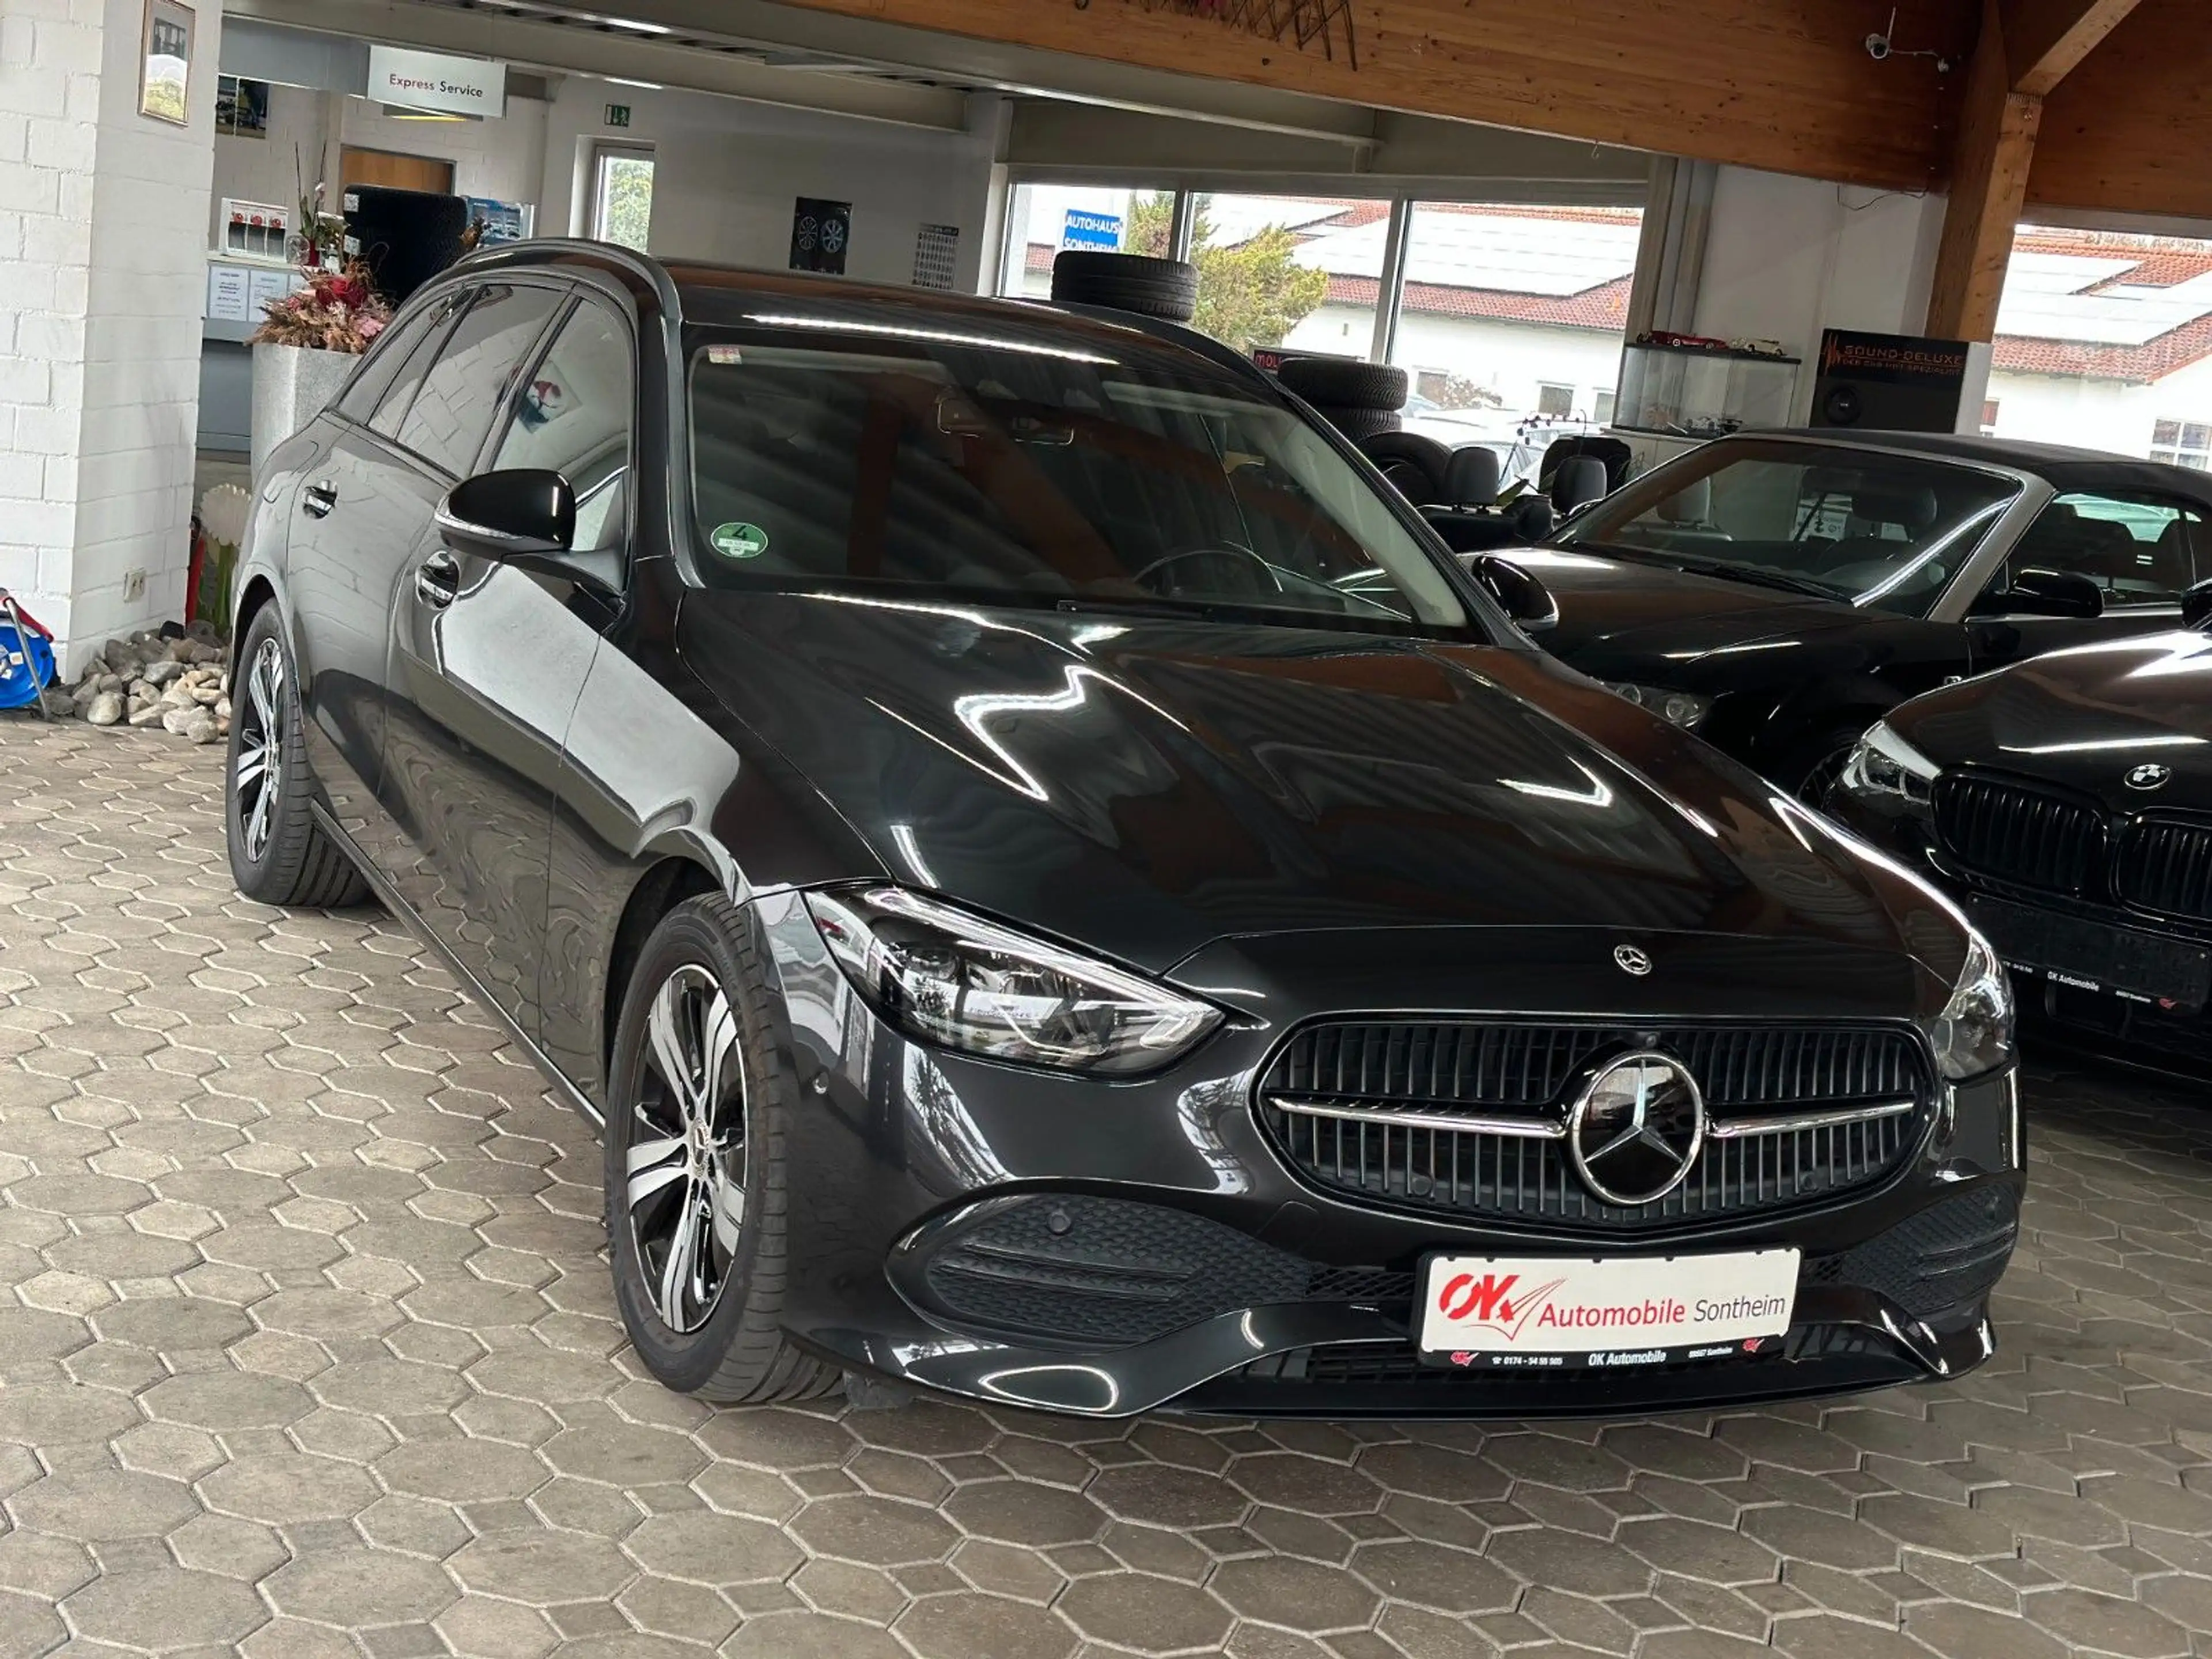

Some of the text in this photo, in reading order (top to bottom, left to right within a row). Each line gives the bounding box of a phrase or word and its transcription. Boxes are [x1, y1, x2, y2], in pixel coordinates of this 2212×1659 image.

[389, 73, 483, 98] Express Service
[1066, 214, 1120, 234] AUTOHAUS
[732, 525, 748, 540] 4
[1440, 1273, 1786, 1327] OK Automobile Sontheim
[1588, 1350, 1666, 1366] OK Automobile
